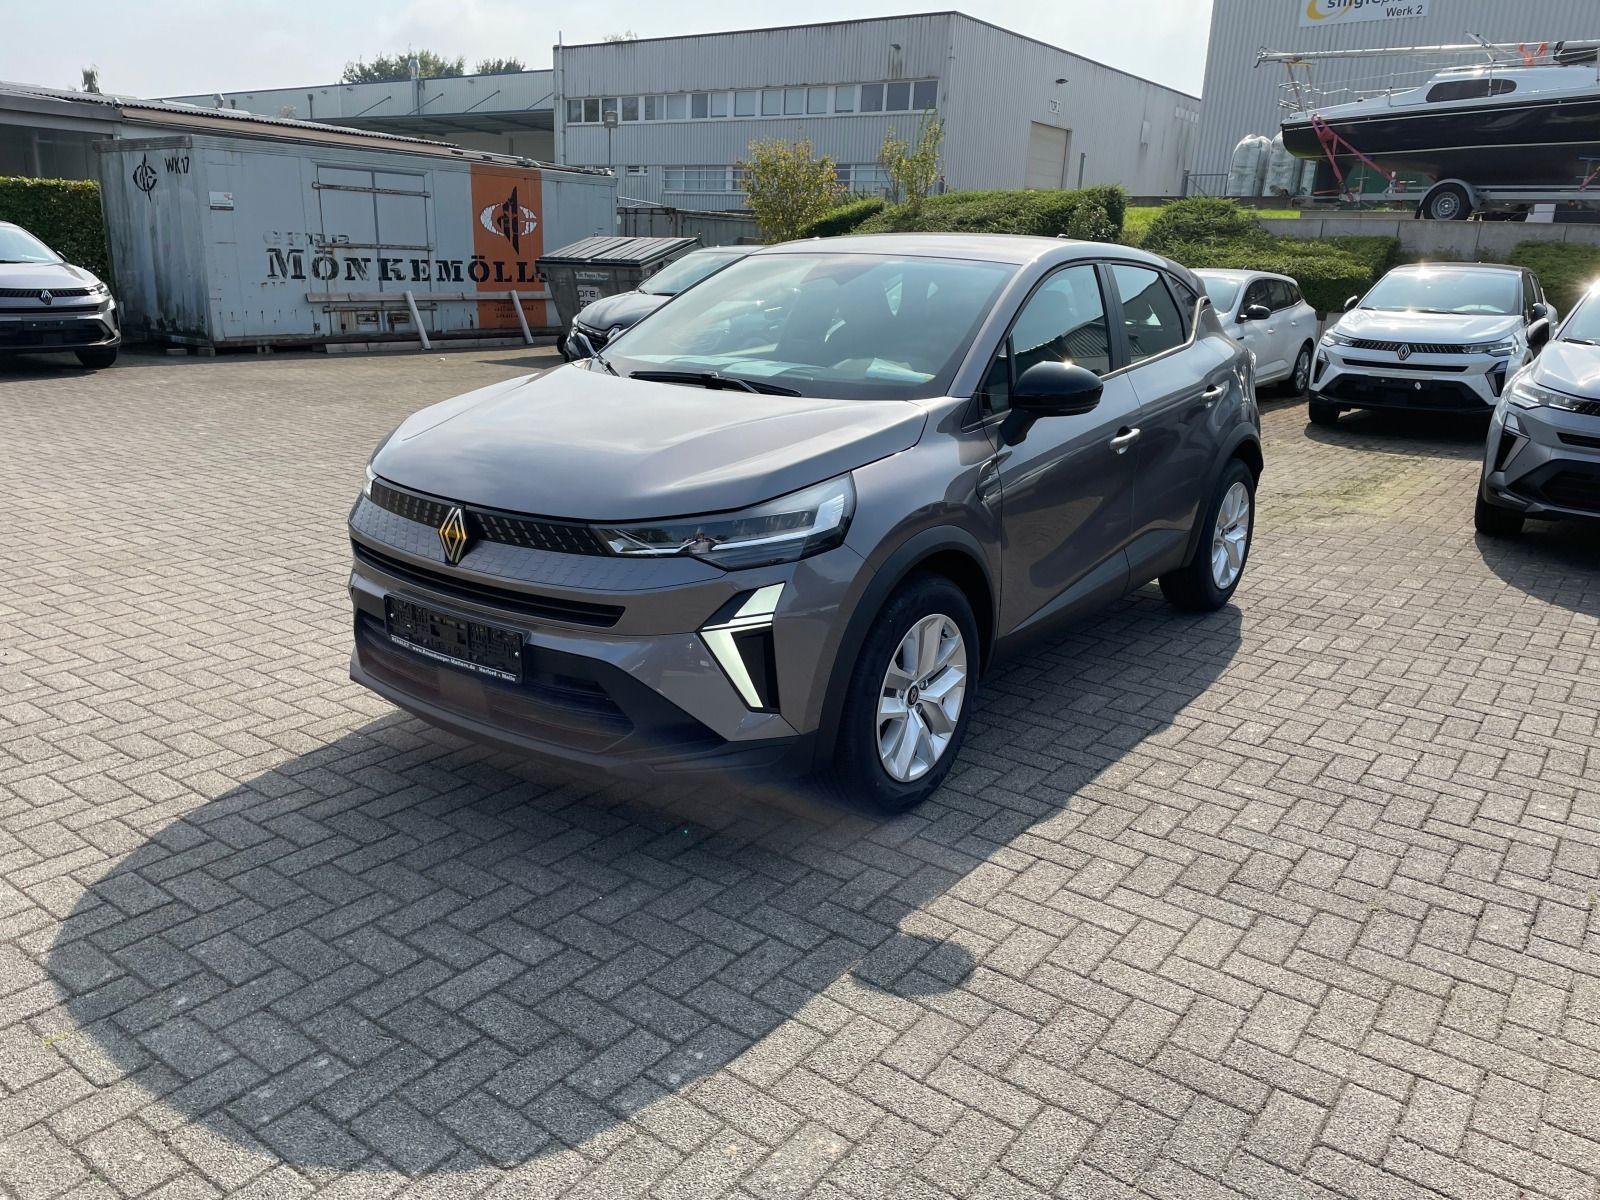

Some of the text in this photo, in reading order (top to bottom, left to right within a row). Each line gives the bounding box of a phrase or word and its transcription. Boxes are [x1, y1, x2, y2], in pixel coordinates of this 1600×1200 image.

[1386, 5, 1423, 17] Werk 2
[265, 247, 546, 283] MÖNKEMÖLL
